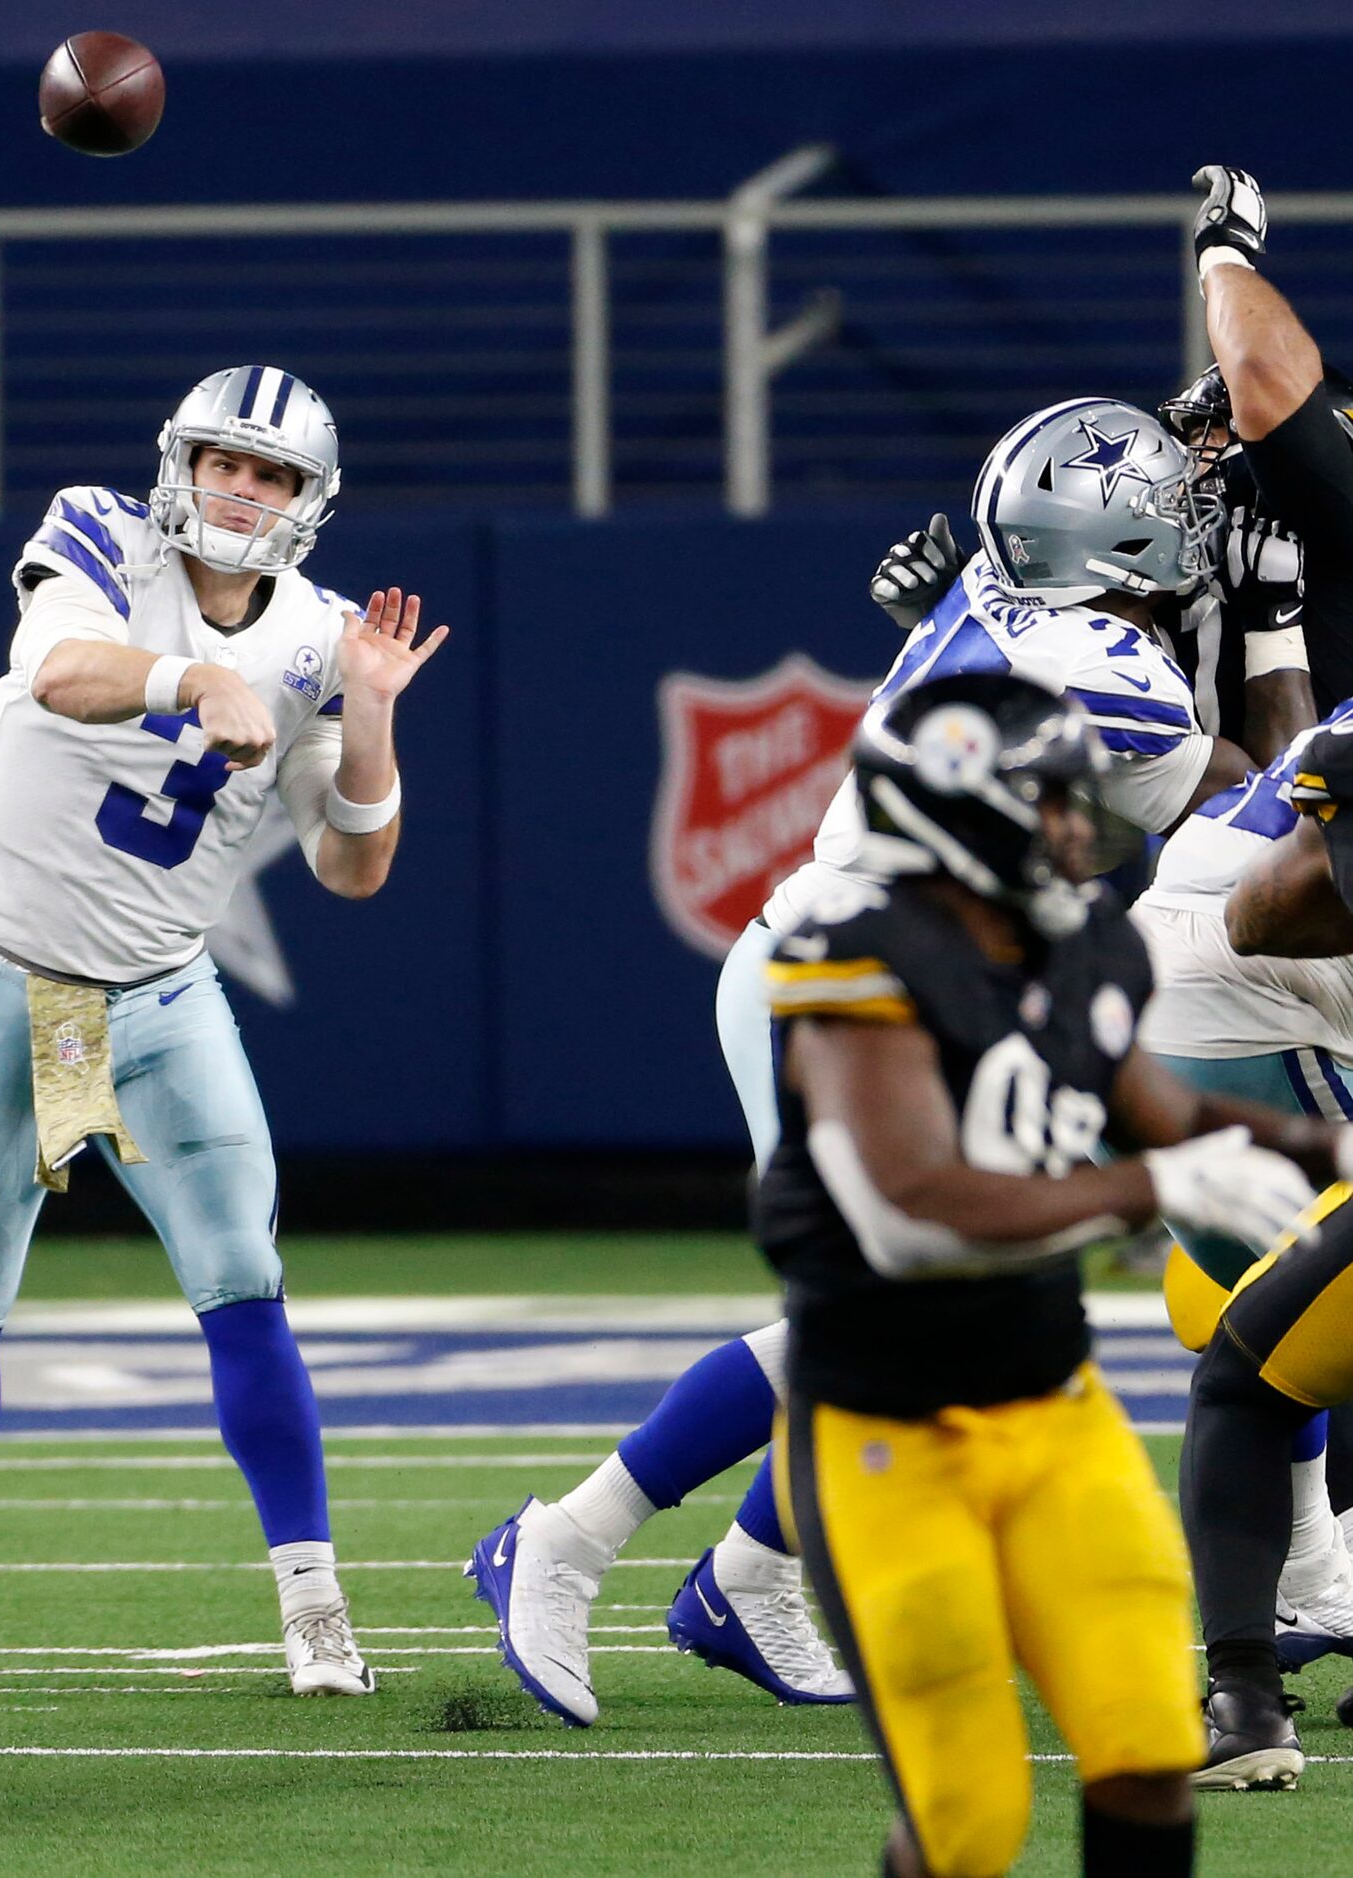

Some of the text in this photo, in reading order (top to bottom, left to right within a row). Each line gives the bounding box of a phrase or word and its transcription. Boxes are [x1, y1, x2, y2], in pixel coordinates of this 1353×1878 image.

[95, 706, 234, 870] 3
[716, 703, 815, 802] THE
[59, 1047, 83, 1061] NFL
